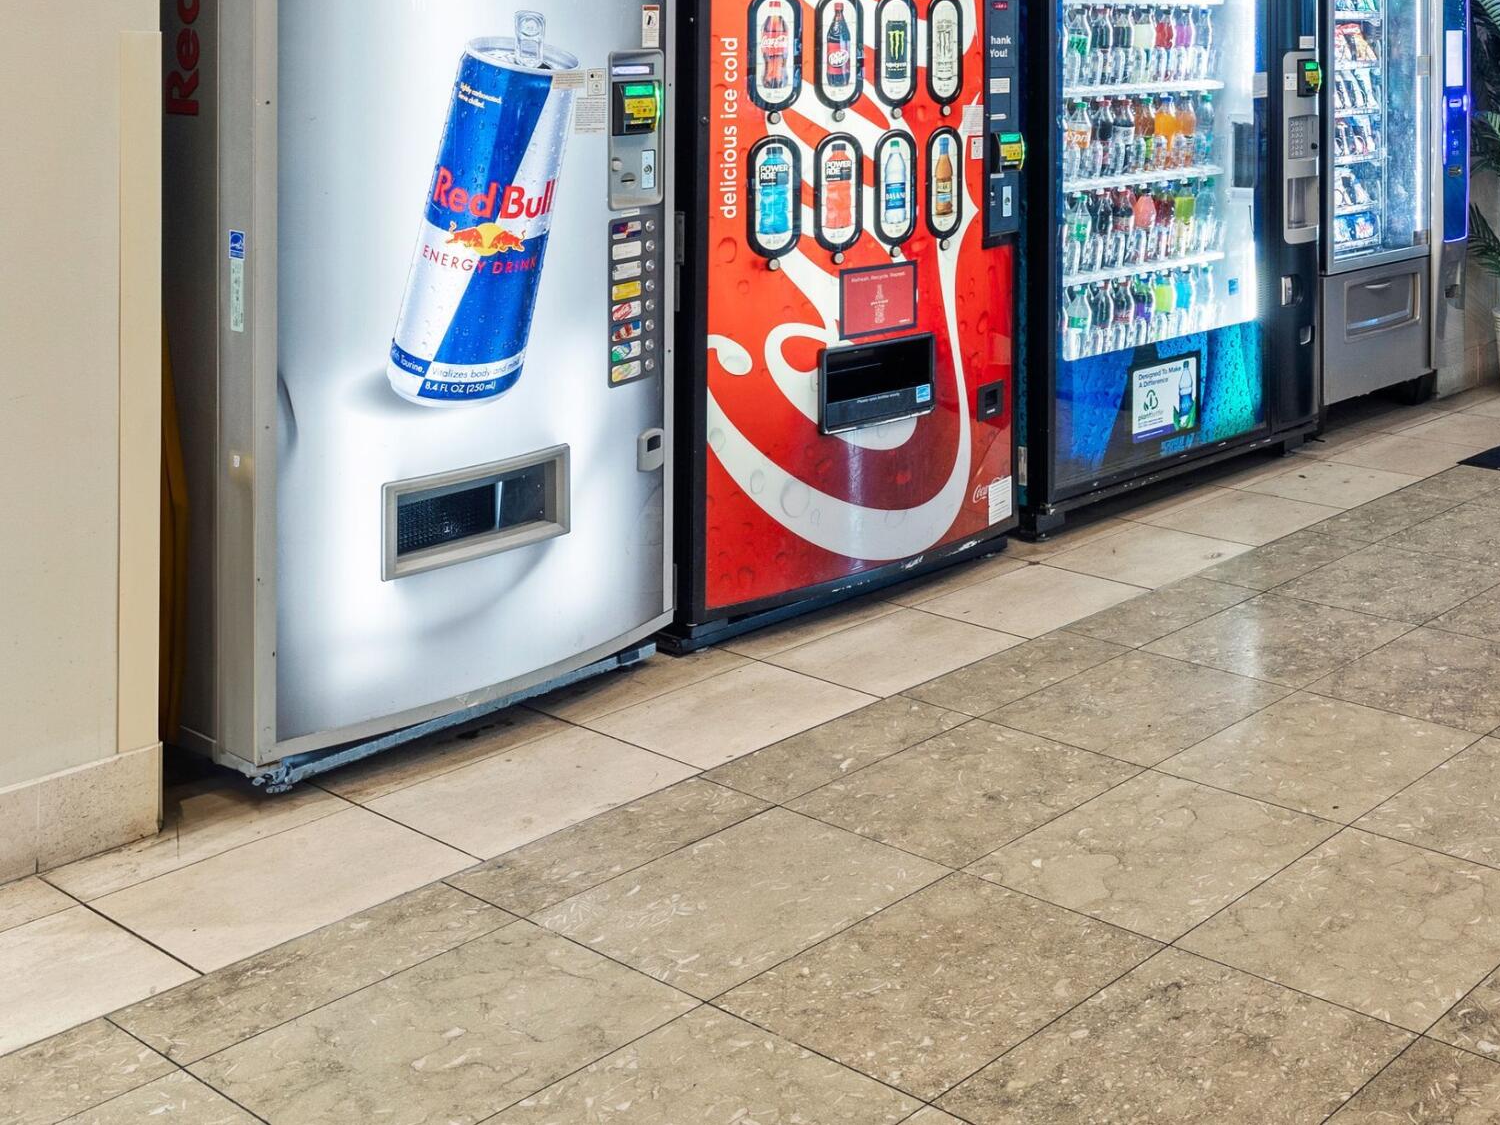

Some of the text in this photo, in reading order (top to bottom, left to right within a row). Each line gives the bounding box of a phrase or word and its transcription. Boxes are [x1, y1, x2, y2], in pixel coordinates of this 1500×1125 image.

[990, 35, 1011, 45] hank
[720, 37, 738, 219] delicious ice cold
[432, 166, 557, 220] Red Bull
[422, 244, 538, 274] ENERGY DRINK
[1168, 365, 1182, 373] Make
[425, 381, 439, 393] 8.4
[440, 384, 448, 393] FL
[450, 384, 465, 393] OZ
